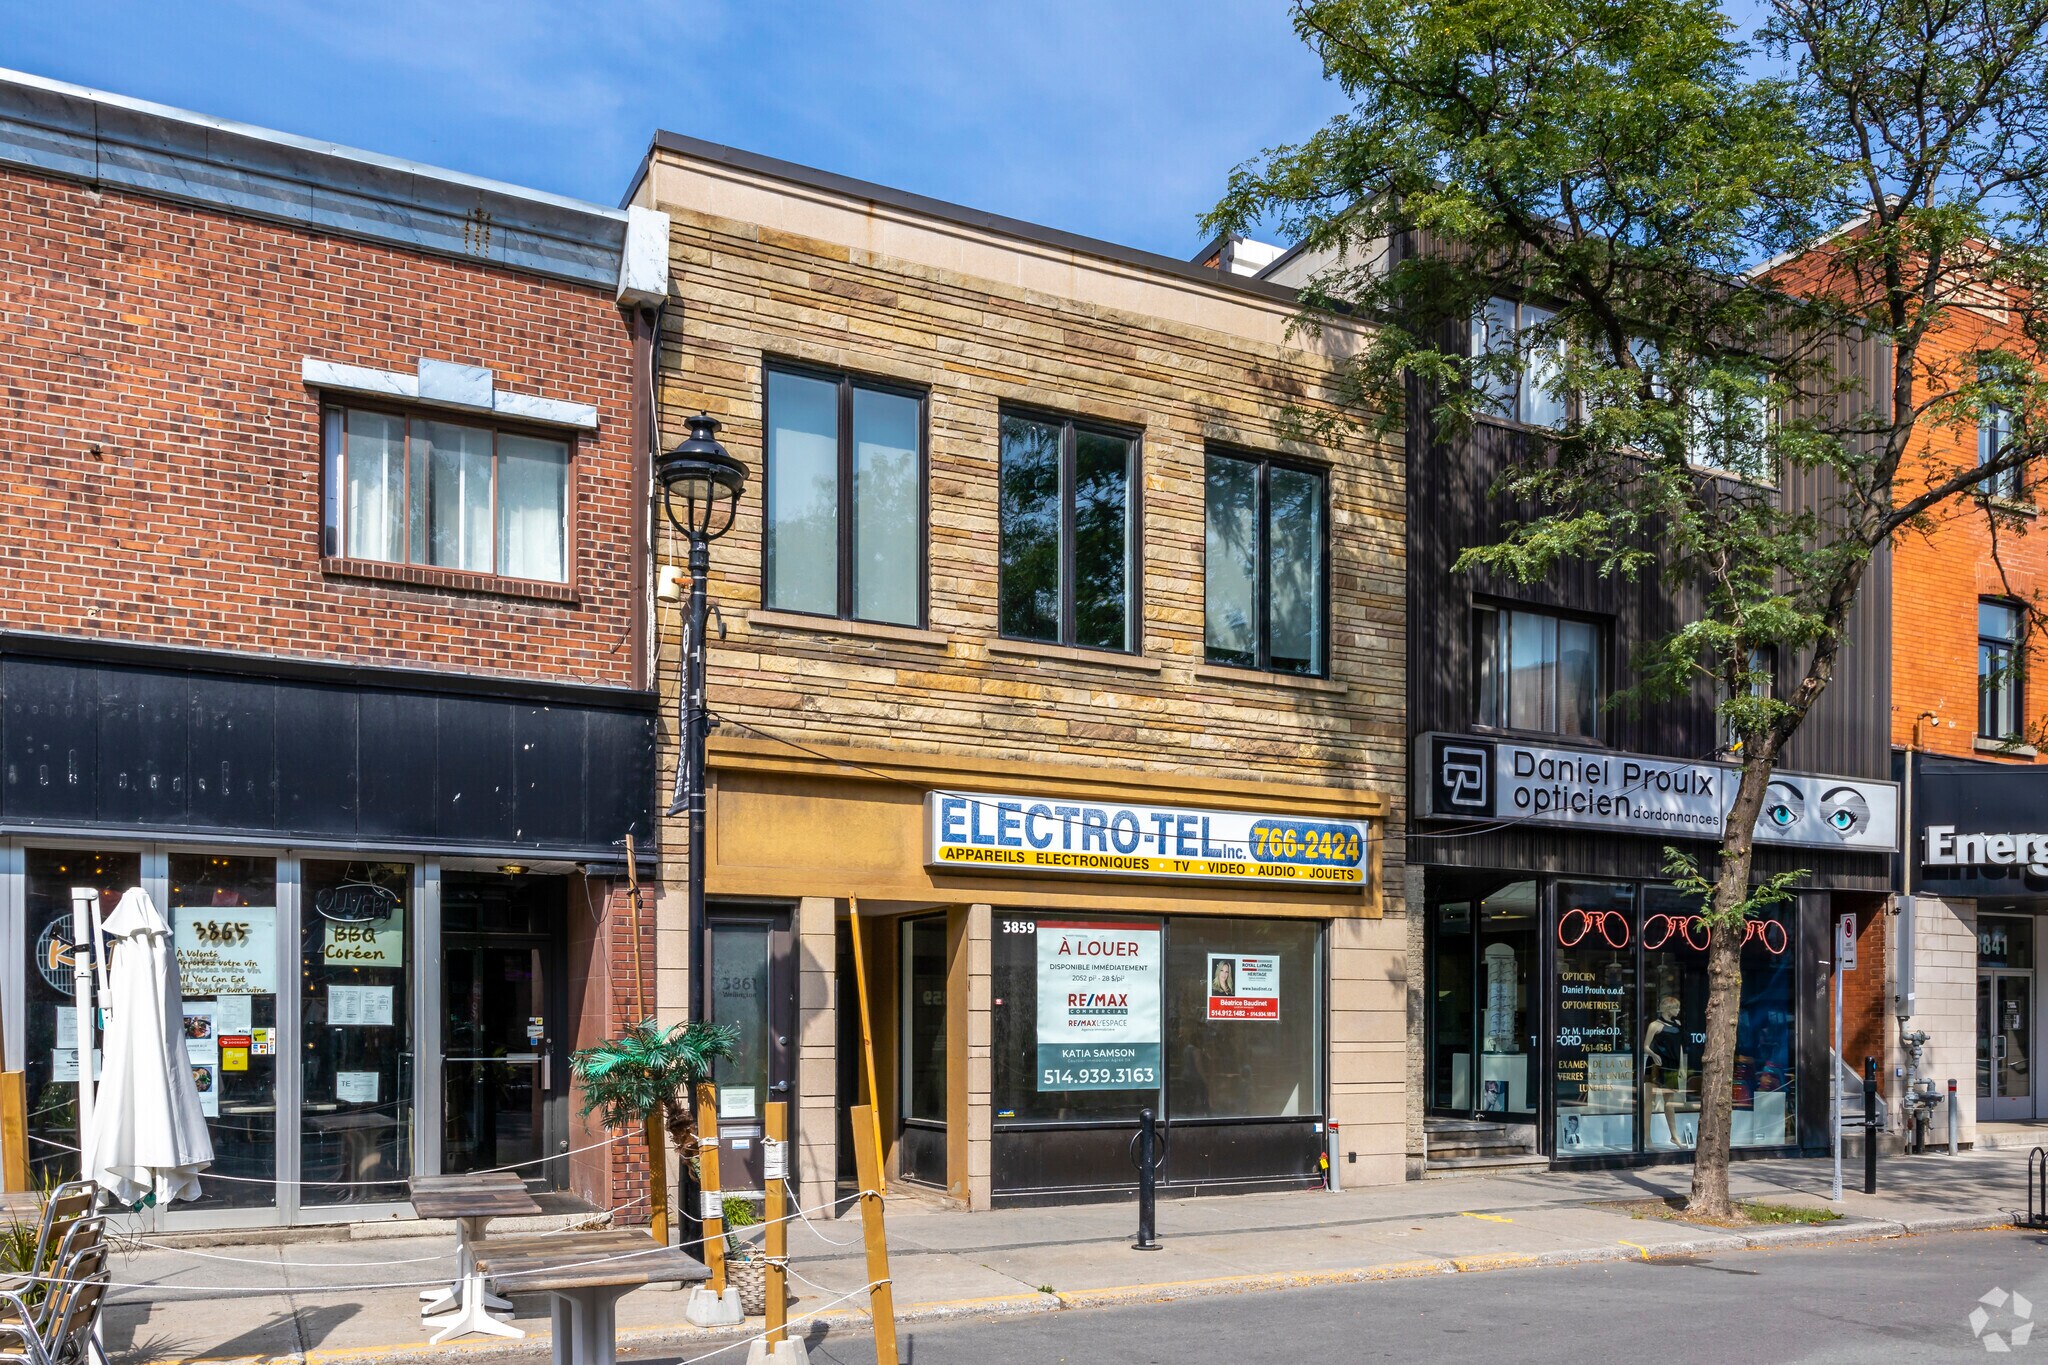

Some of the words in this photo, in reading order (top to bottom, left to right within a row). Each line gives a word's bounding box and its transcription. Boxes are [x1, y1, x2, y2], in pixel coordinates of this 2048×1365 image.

[1513, 749, 1608, 786] Daniel
[1623, 763, 1714, 797] Proulx
[1513, 784, 1630, 818] opticien
[1633, 805, 1720, 826] d'ordonnances
[941, 797, 1222, 859] ELECTRO-TEL
[1222, 843, 1247, 861] Inc.
[1253, 826, 1361, 862] 766-2424
[945, 847, 1026, 864] APPAREILS
[1036, 852, 1150, 871] ELECTRONIQUES
[1173, 860, 1190, 872] TV
[1207, 862, 1246, 875] VIDEO
[1257, 864, 1296, 877] AUDIO
[1308, 867, 1355, 881] JOUETS
[193, 920, 250, 941] 3865
[1002, 920, 1036, 935] 3859
[334, 924, 376, 944] BBQ
[1057, 936, 1072, 956] À
[1077, 940, 1140, 957] LOUER
[1977, 933, 2008, 956] 841
[176, 946, 184, 957] À
[325, 944, 386, 960] Coréen
[177, 958, 216, 969] Apportez
[218, 959, 242, 969] votre
[244, 959, 258, 967] vin
[1049, 963, 1091, 971] DISPONIBLE
[1091, 964, 1148, 972] IMMÉDIATEMENT
[192, 974, 208, 983] You
[211, 975, 228, 983] Can
[230, 975, 246, 983] Eat
[1072, 974, 1088, 982] 2052
[1561, 972, 1596, 982] OPTICIEN
[721, 976, 758, 990] 3861
[181, 985, 200, 995] ring
[203, 986, 223, 995] your
[246, 985, 268, 993] wine
[1561, 985, 1584, 994] Daniel
[1584, 985, 1606, 995] Proulx
[1606, 985, 1625, 995] o.o.d.
[1068, 993, 1128, 1007] RE/MAX
[1243, 999, 1268, 1007] Baudinet
[1561, 1000, 1620, 1010] OPTOMETRISTES
[1068, 1019, 1097, 1027] RE/MAX
[1561, 1026, 1571, 1036] Dr
[1571, 1026, 1581, 1036] M.
[1582, 1026, 1605, 1037] Laprise
[1606, 1026, 1622, 1036] O.D.
[1062, 1049, 1092, 1058] KATIA
[1093, 1048, 1136, 1058] SAMSON
[1580, 1043, 1612, 1053] 761-4545
[1558, 1060, 1589, 1069] EXAMEN
[1592, 1060, 1602, 1069] DE
[1605, 1060, 1615, 1069] LA
[1043, 1067, 1155, 1085] 514.939.3163
[1557, 1072, 1584, 1081] VERRES
[1588, 1071, 1597, 1079] DE
[1600, 1071, 1635, 1080] CONTACT
